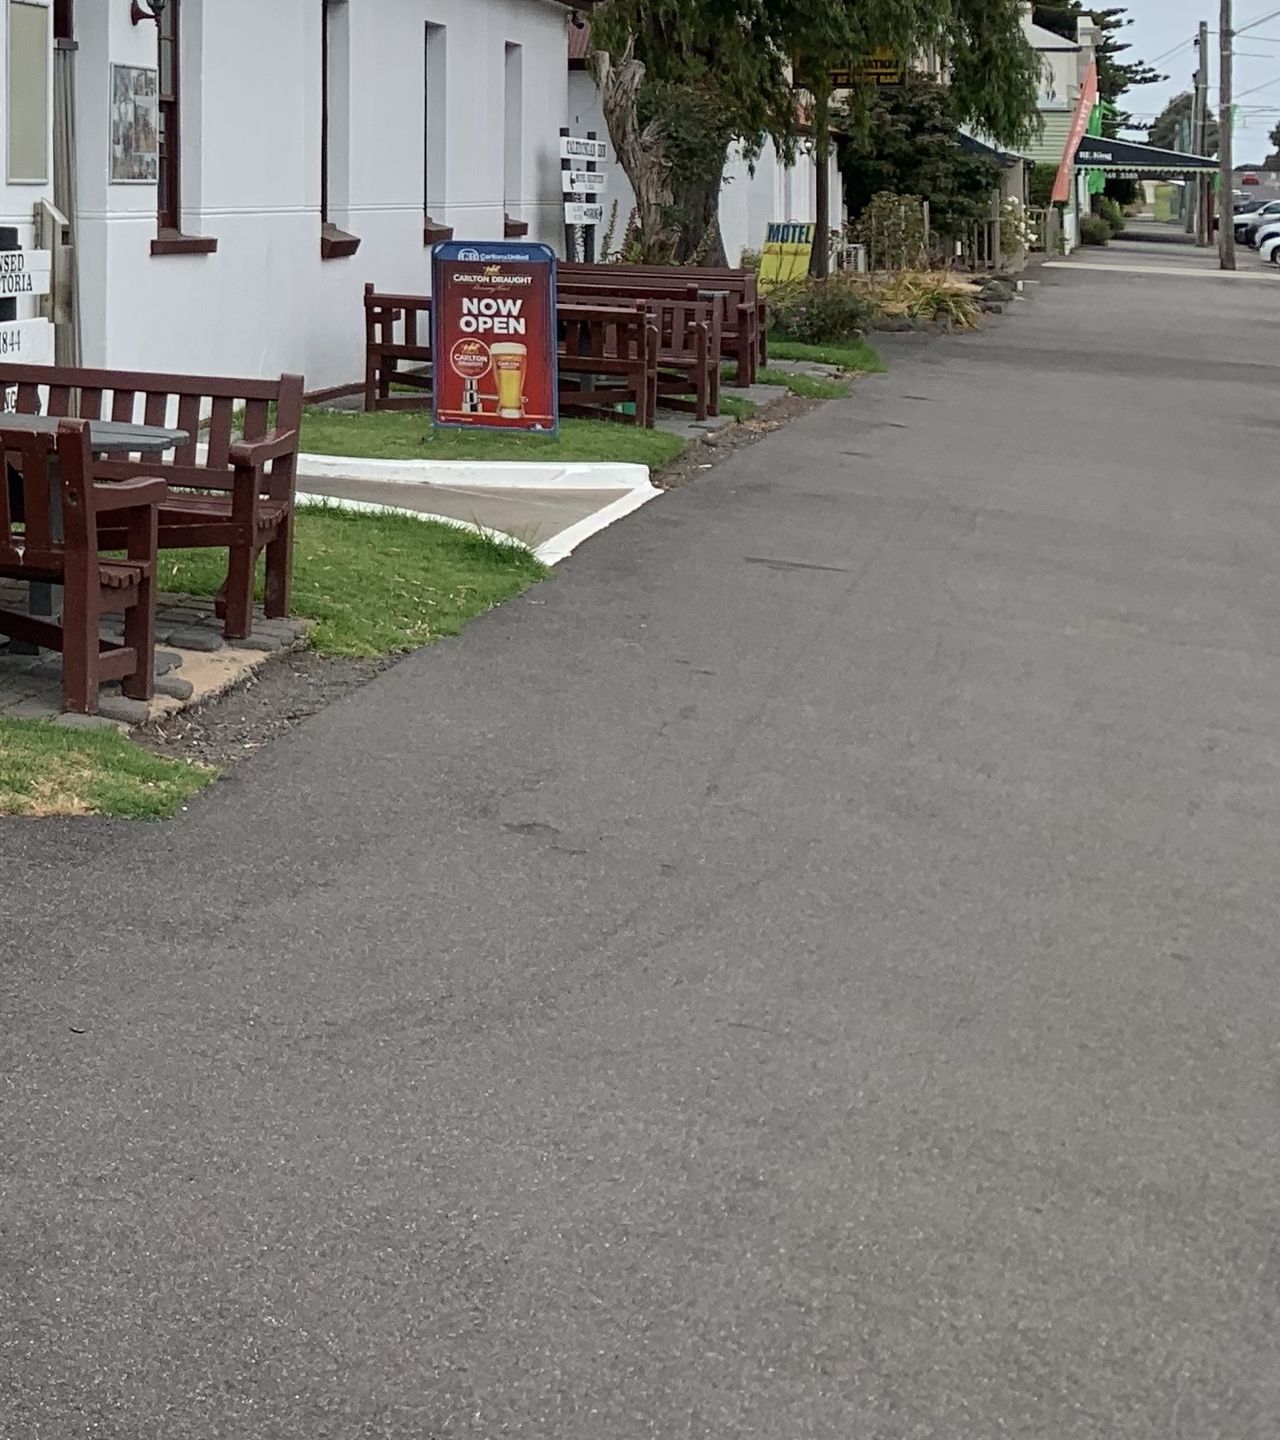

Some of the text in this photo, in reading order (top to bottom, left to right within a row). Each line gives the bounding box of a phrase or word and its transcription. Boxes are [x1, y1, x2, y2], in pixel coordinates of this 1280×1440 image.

[768, 224, 811, 243] MOTEL
[453, 273, 533, 284] CARLTON DRAUGHT
[462, 297, 523, 316] NOW
[459, 315, 526, 335] OPEN
[454, 354, 487, 363] CARLTON
